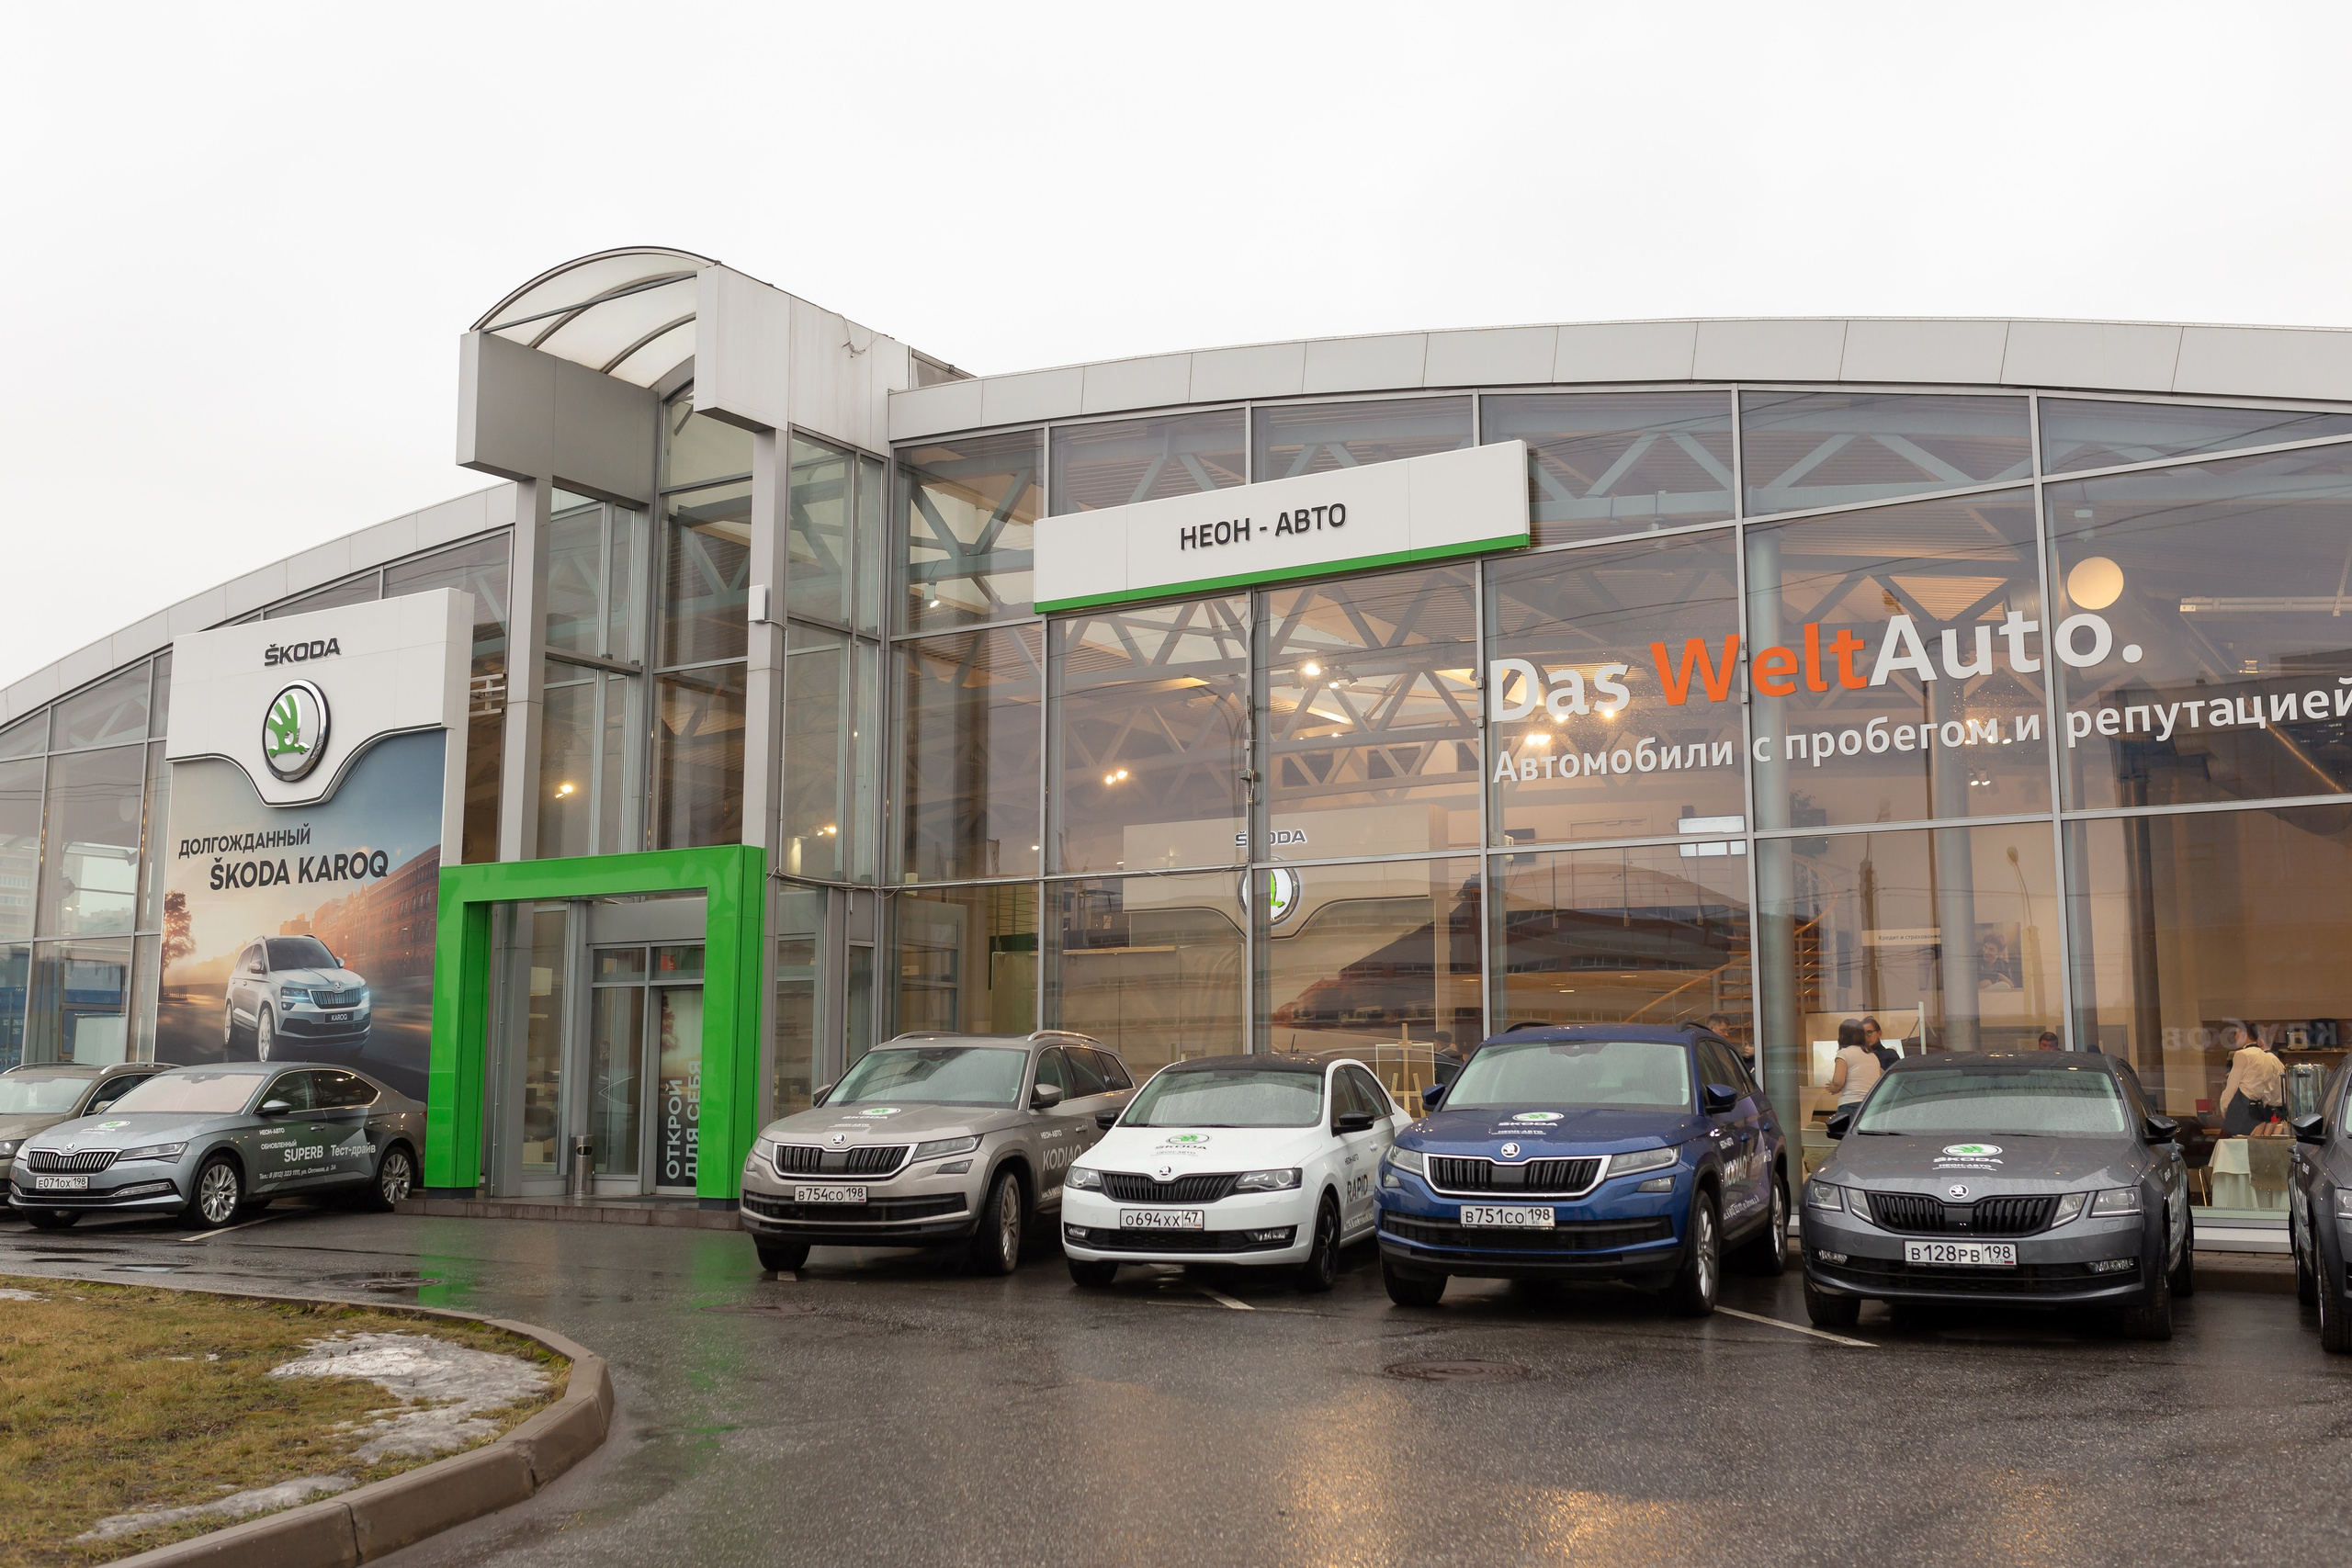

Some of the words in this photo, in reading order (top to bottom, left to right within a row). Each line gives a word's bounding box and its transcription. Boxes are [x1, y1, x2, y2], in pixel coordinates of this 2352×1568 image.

[1180, 517, 1250, 551] НЕОН
[1275, 502, 1348, 537] АВТО
[264, 637, 342, 666] ŠKODA
[1490, 659, 1631, 723] Das
[1493, 737, 1734, 784] Автомобили
[1753, 736, 1771, 762] с
[1785, 716, 1998, 768] пробегом
[2016, 714, 2041, 742] и
[2065, 677, 2352, 749] репутацией
[178, 823, 311, 859] ДОЛГОЖДАННЫЙ
[209, 858, 290, 891] ŠKODA
[298, 850, 389, 883] KAROQ
[331, 1013, 347, 1021] KAROQ
[686, 1061, 701, 1122] СЕБЯ
[665, 1079, 683, 1179] ОТКРОЙ
[260, 1139, 298, 1150] ОБНОВЛЕННЫЙ
[284, 1145, 323, 1162] SUPERB
[331, 1142, 377, 1157] Тест-драйв
[39, 1178, 71, 1188] Е071ОХ
[798, 1188, 843, 1201] В754СО
[846, 1188, 864, 1198] 198
[1347, 1174, 1369, 1203] RAPID
[1125, 1212, 1181, 1226] О694ХХ
[1184, 1212, 1198, 1223] 47
[1465, 1208, 1525, 1224] В751СО
[1528, 1208, 1550, 1221] 198
[1911, 1245, 1981, 1262] В128РВ
[1984, 1246, 2011, 1258] 198
